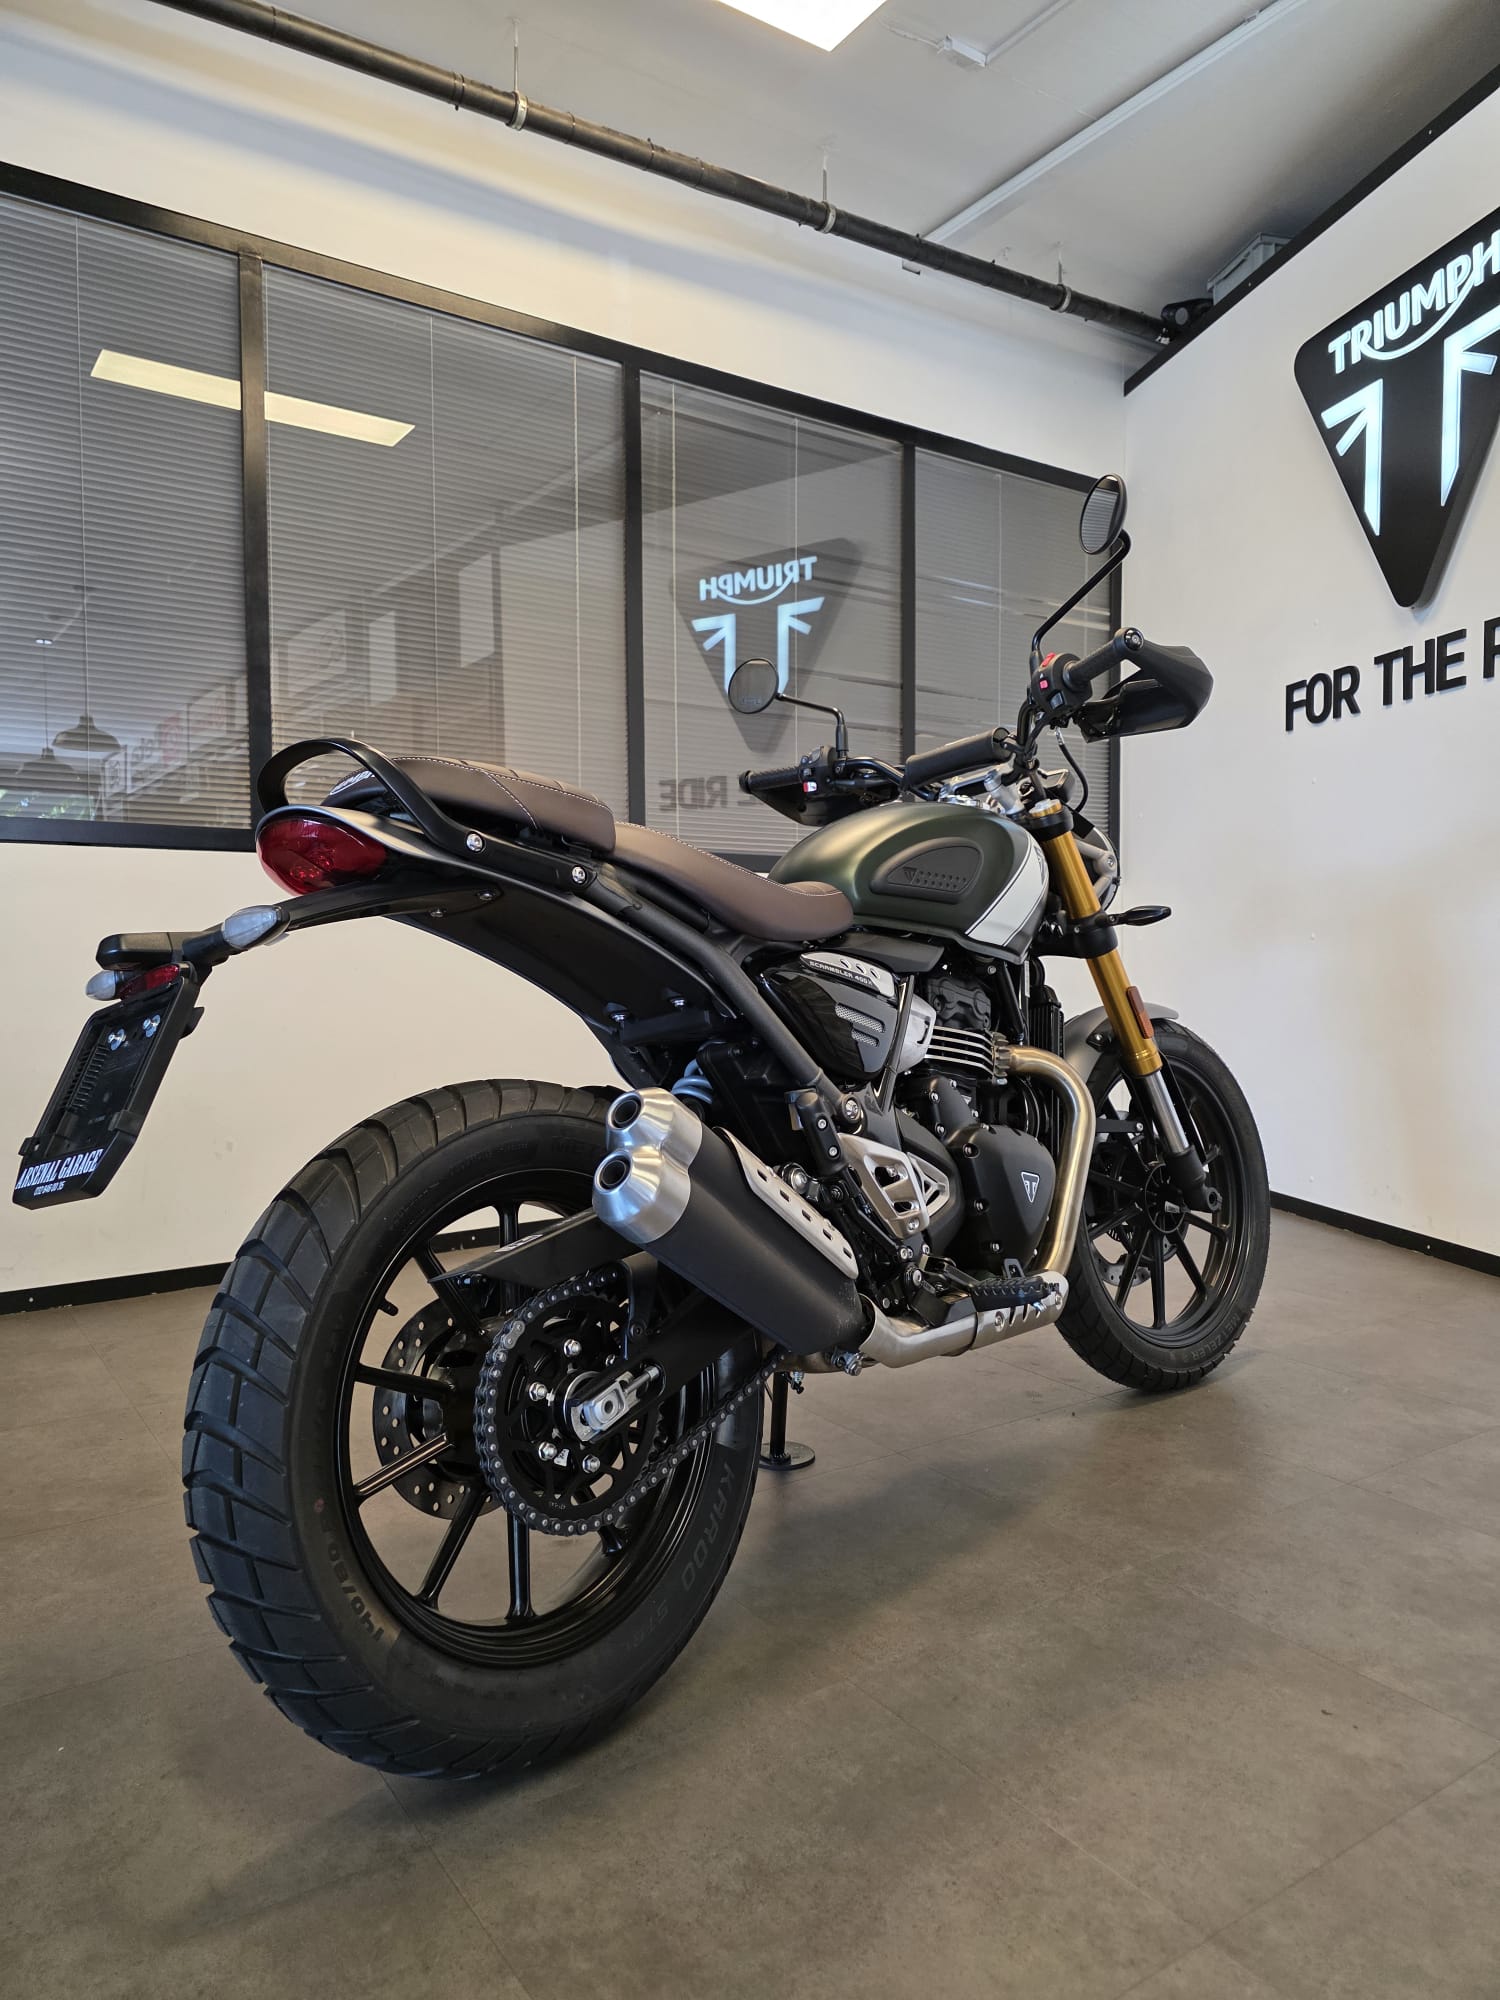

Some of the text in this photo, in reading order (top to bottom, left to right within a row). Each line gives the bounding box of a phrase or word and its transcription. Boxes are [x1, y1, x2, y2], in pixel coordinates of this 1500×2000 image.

[1328, 229, 1500, 374] TRIUMPH
[1285, 665, 1361, 732] FOR
[1374, 628, 1468, 706] THE
[58, 1148, 104, 1180] GARAGE
